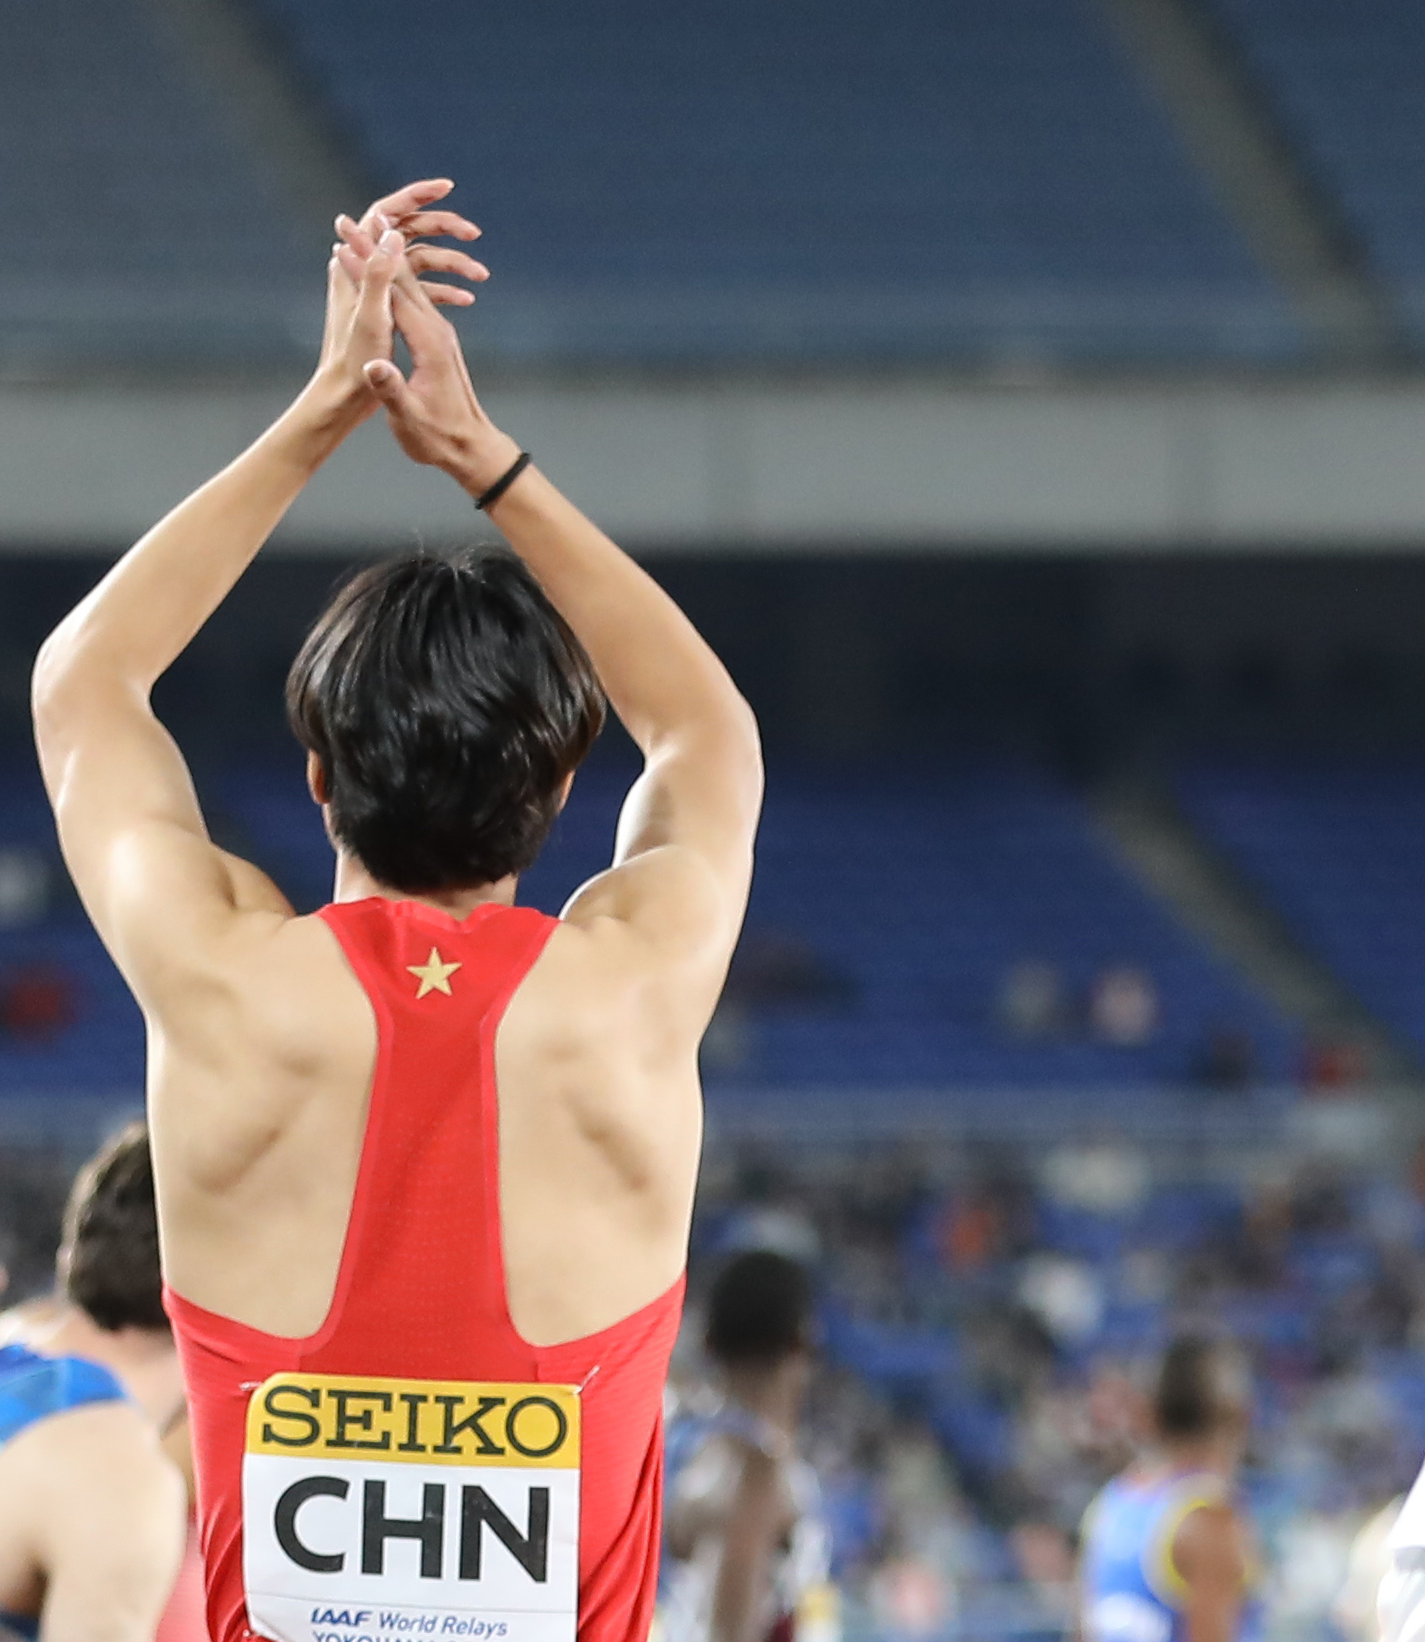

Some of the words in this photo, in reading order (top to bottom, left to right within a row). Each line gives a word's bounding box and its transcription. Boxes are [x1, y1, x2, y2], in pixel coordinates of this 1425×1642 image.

[262, 1384, 567, 1458] SEIKO
[273, 1475, 550, 1584] CHN
[310, 1607, 373, 1627] IAAF
[379, 1612, 436, 1634] World
[440, 1616, 509, 1640] Relays
